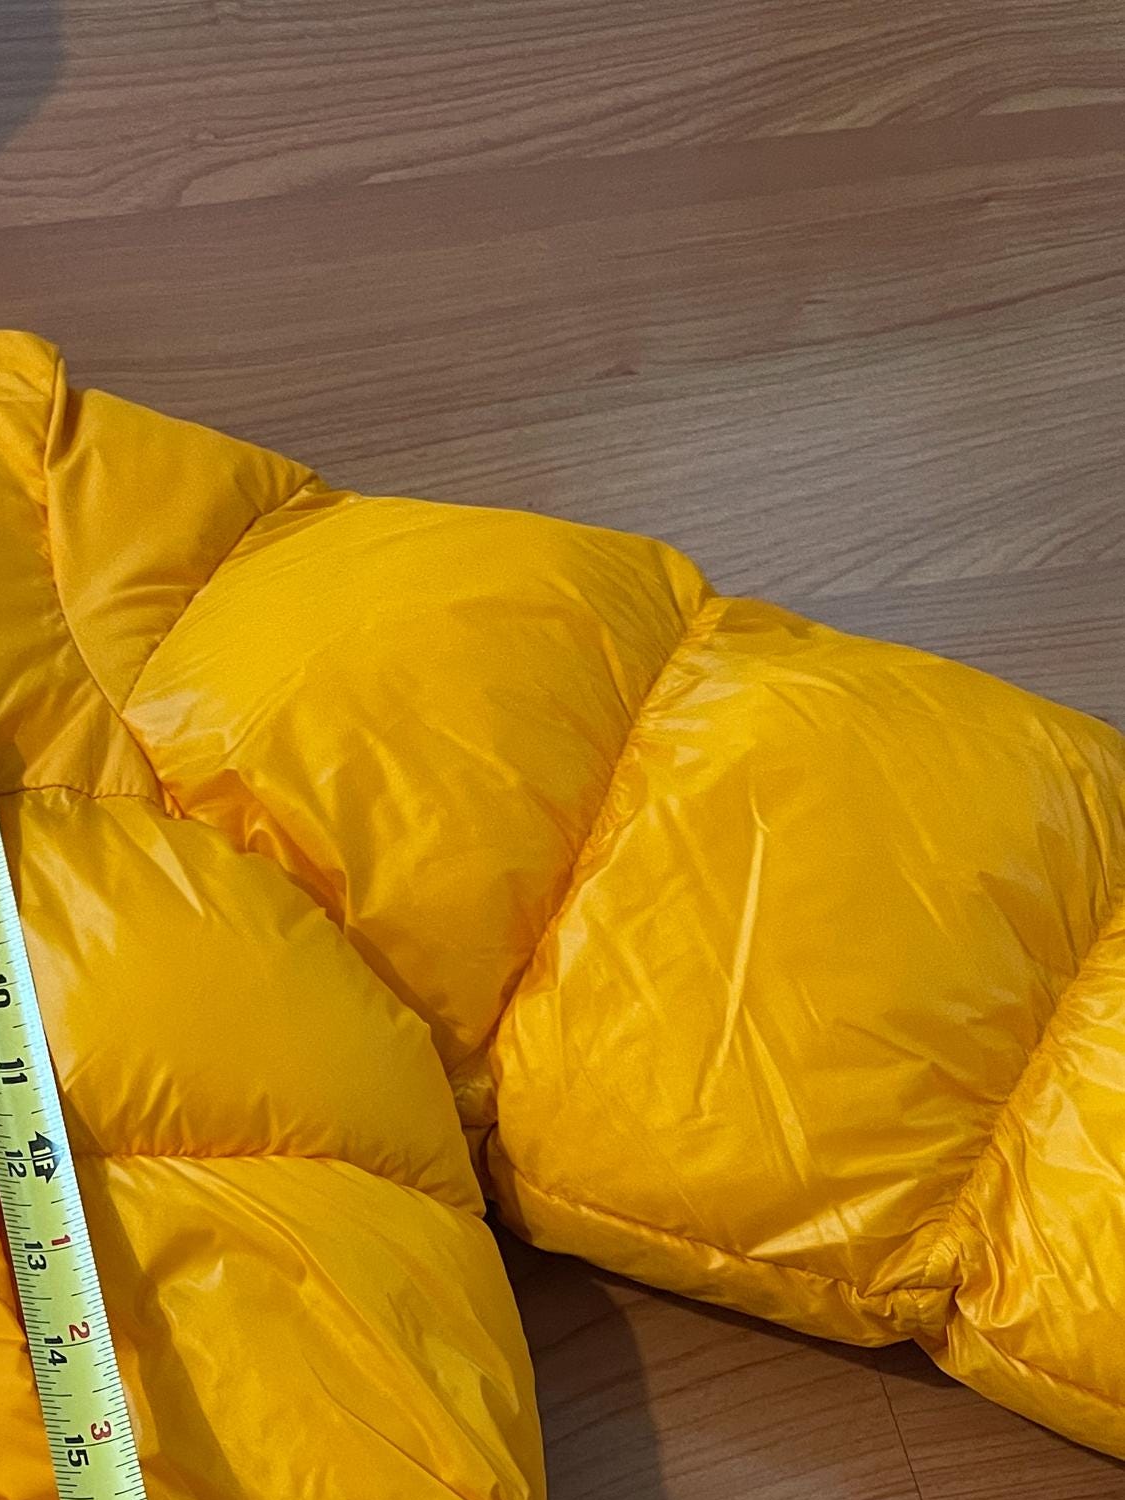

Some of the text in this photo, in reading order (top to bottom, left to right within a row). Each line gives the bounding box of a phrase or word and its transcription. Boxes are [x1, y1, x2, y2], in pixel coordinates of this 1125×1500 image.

[5, 1149, 27, 1178] 12
[51, 1234, 71, 1247] 1
[24, 1240, 47, 1271] 13
[68, 1321, 91, 1341] 2
[43, 1335, 68, 1366] 14
[90, 1421, 112, 1441] 3
[64, 1434, 90, 1468] 15
